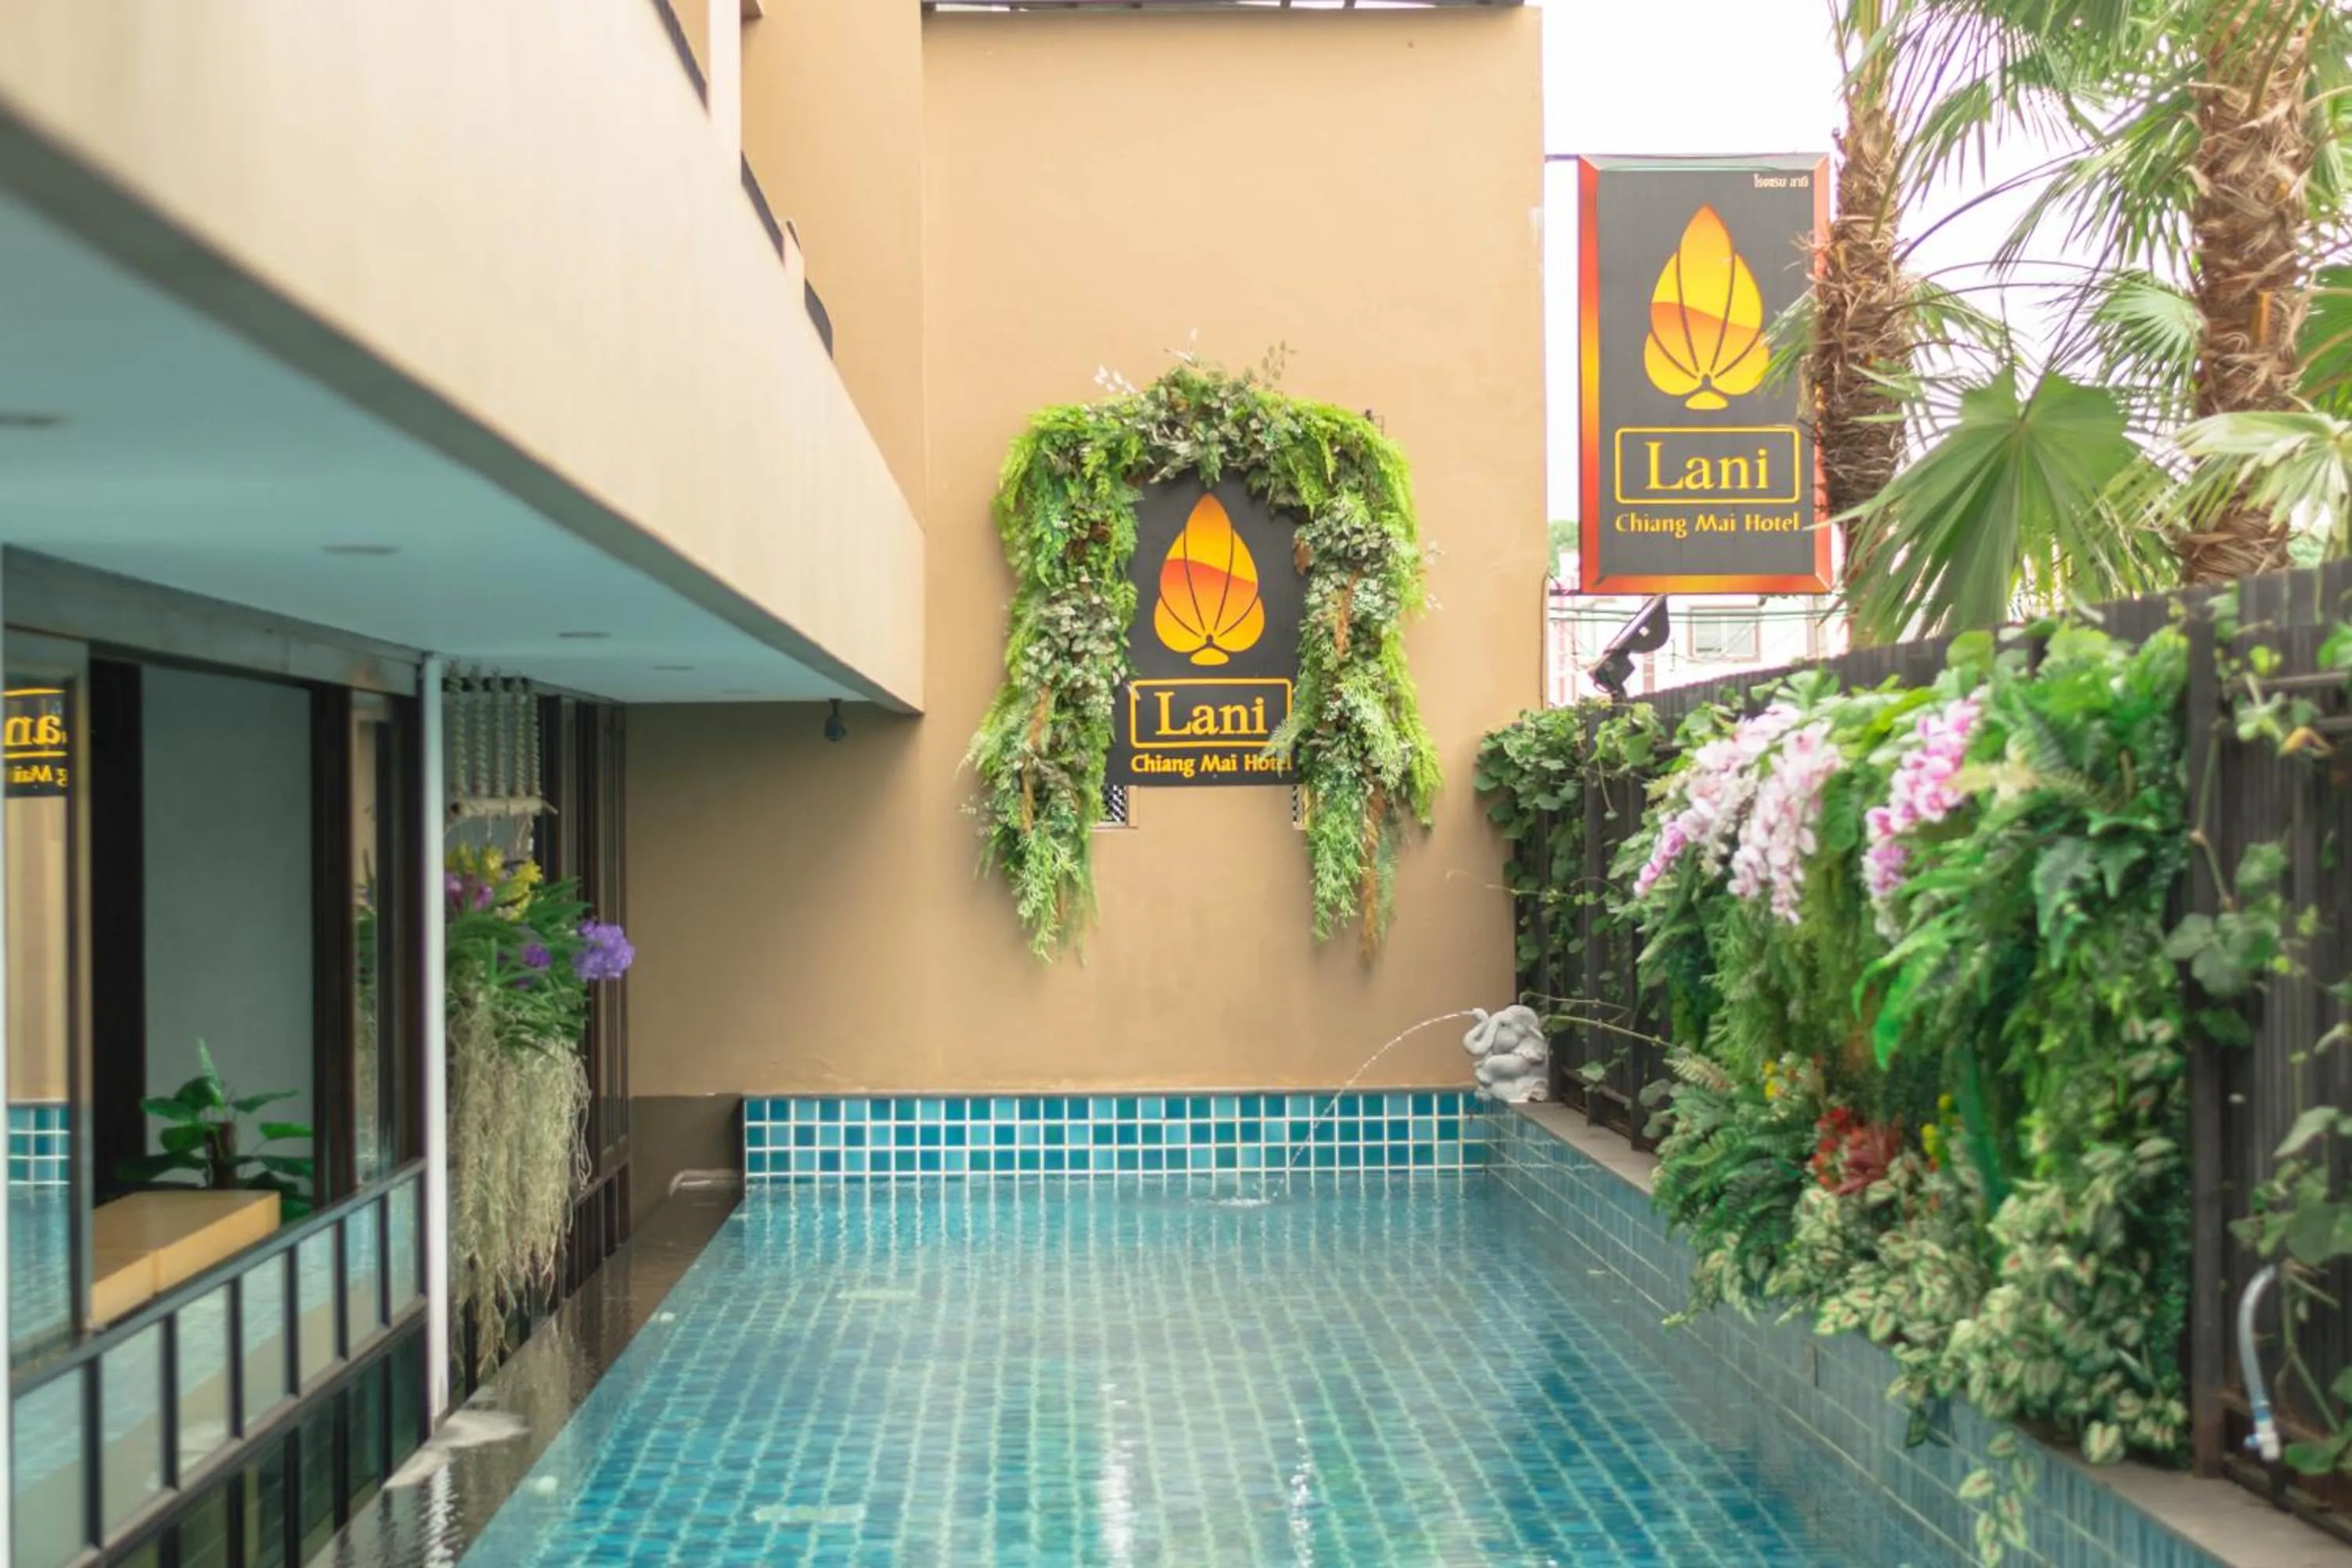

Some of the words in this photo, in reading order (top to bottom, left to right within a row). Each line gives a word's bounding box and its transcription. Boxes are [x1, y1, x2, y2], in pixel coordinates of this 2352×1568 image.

[1644, 441, 1769, 491] Lani
[1615, 512, 1688, 539] Chiang
[1695, 513, 1736, 532] Mai
[1745, 511, 1800, 532] Hotel
[1154, 691, 1268, 735] Lani
[1131, 753, 1196, 779] Chiang
[1200, 754, 1238, 772] Mai
